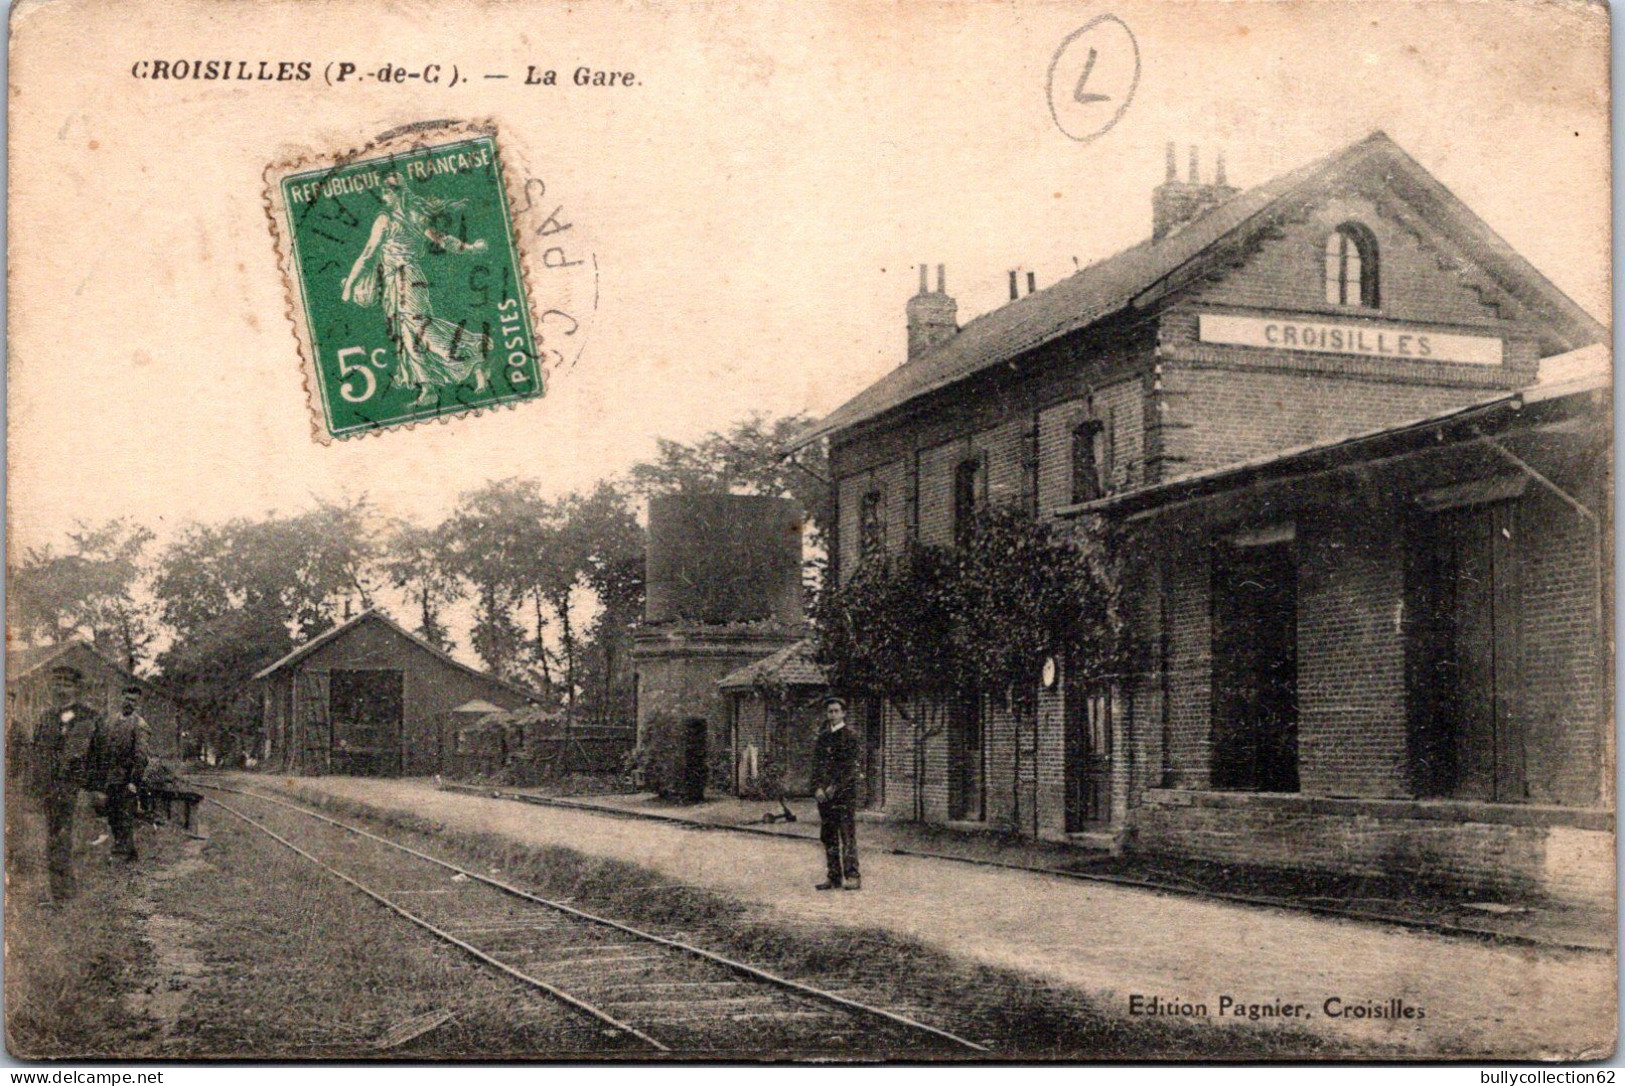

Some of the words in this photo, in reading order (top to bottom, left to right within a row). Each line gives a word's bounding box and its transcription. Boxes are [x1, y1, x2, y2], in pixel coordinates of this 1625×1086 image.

[131, 59, 313, 82] CROISILLES
[524, 65, 558, 86] La
[573, 66, 643, 88] Gare.
[497, 297, 532, 385] POSTES
[1264, 323, 1433, 357] CROISILLES
[1128, 993, 1208, 1018] Edition
[1218, 994, 1312, 1023] Pagnier,
[1323, 996, 1426, 1021] Croisilles
